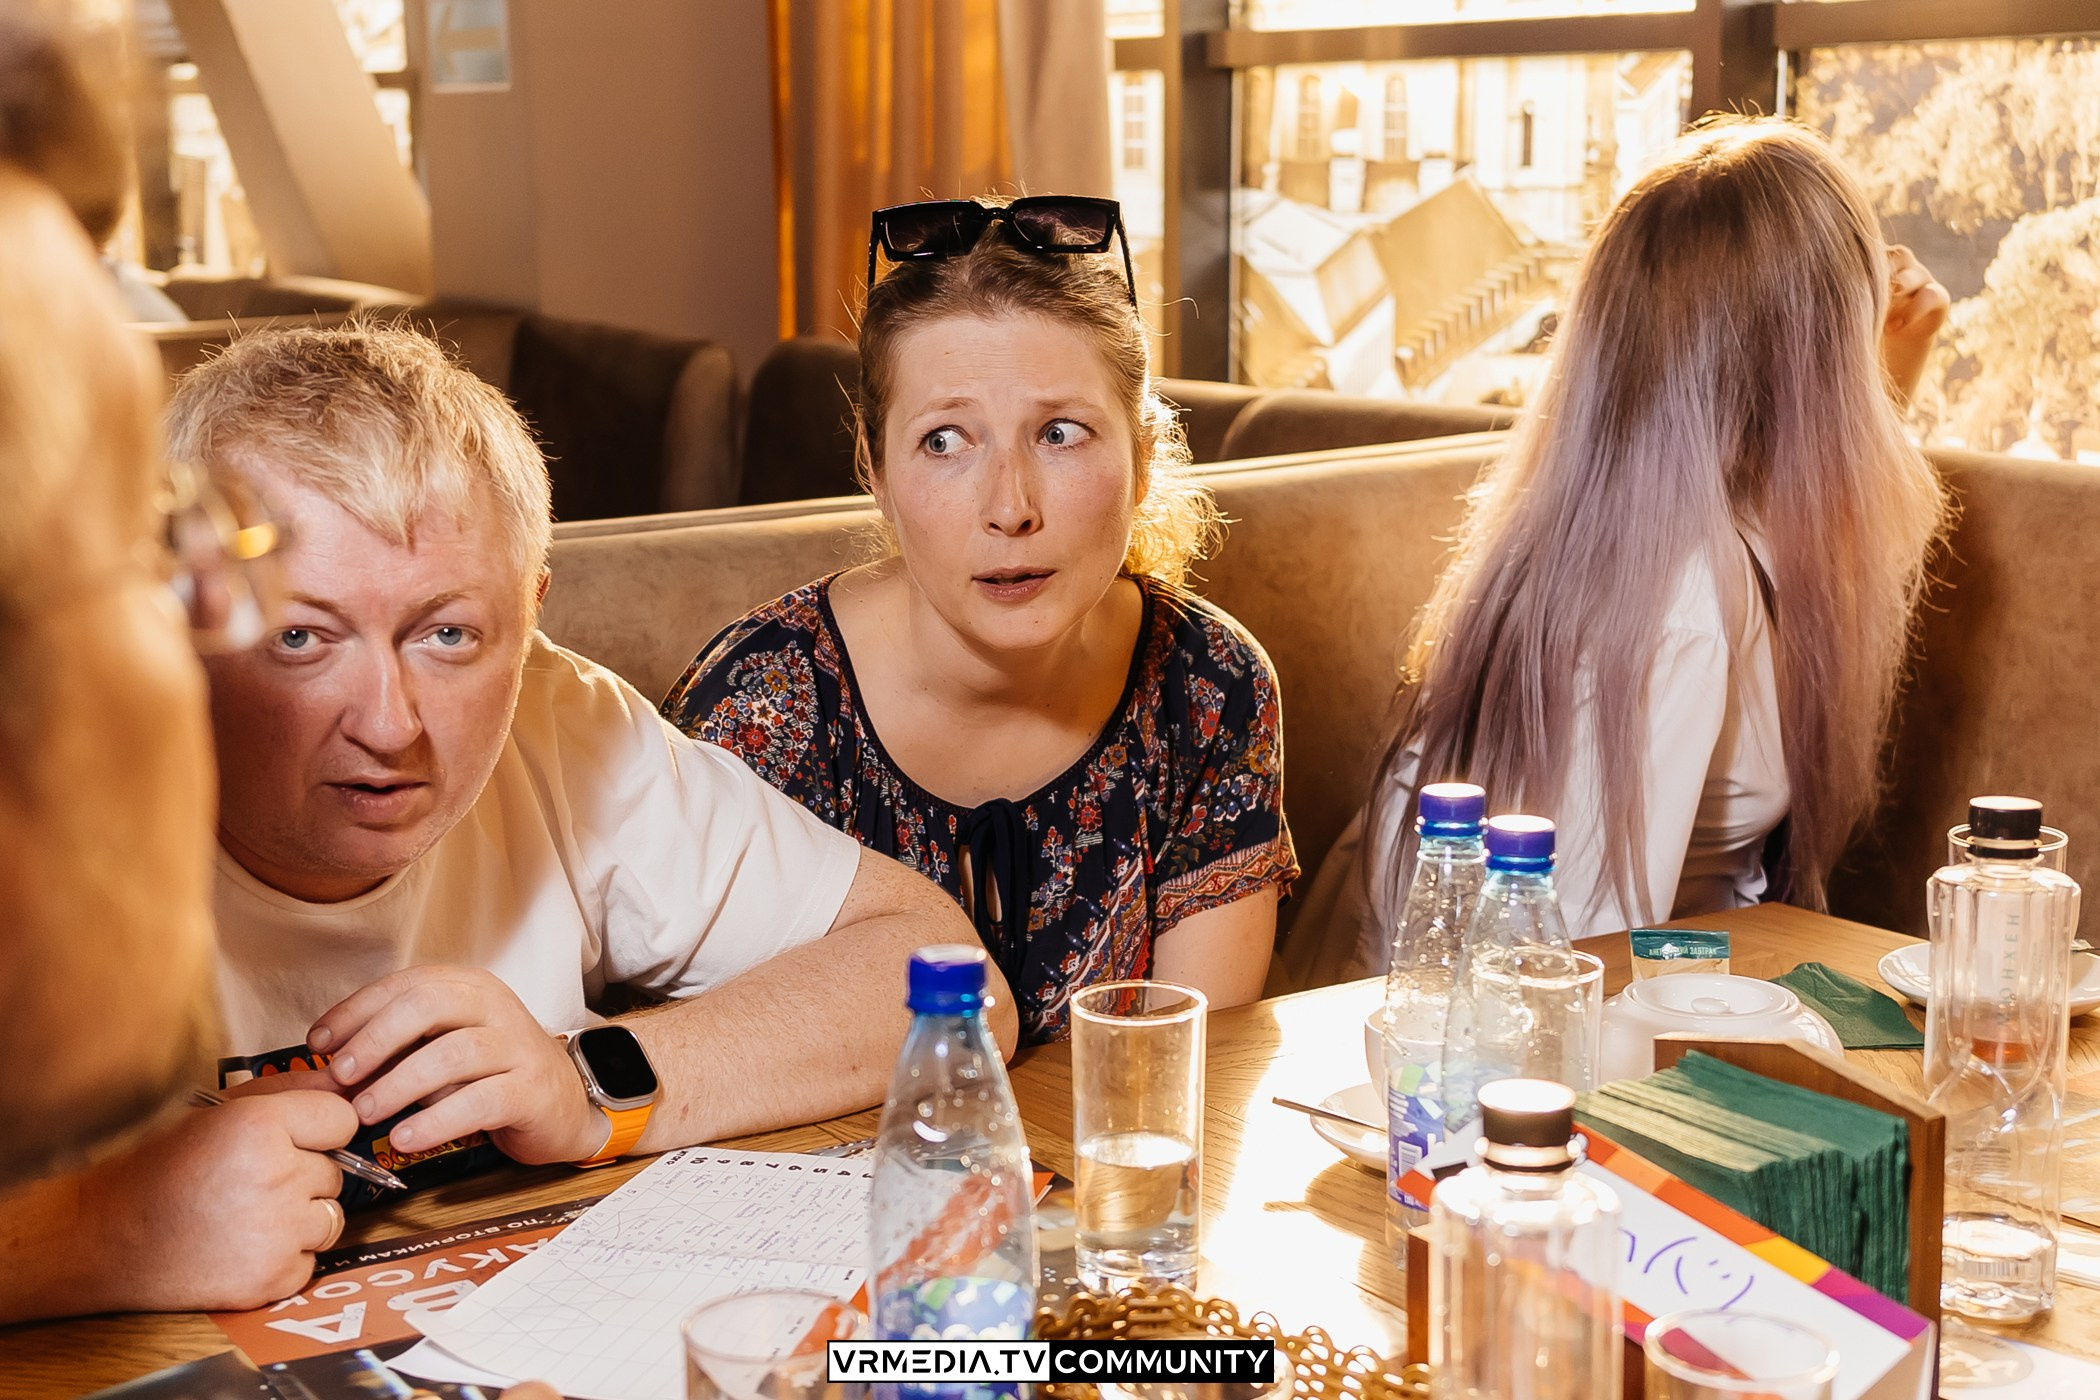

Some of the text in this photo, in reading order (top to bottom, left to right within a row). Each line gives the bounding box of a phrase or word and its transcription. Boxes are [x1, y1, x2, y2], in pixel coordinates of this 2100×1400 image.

[689, 1155, 709, 1165] 10
[717, 1158, 731, 1166] 9
[739, 1159, 755, 1167] 8
[765, 1162, 780, 1170] 7
[813, 1167, 829, 1175] 5
[506, 1218, 538, 1229] ПО
[358, 1224, 501, 1262] ВТОРНИКАМ
[268, 1237, 549, 1313] АКУСОК
[264, 1279, 478, 1345] ВА
